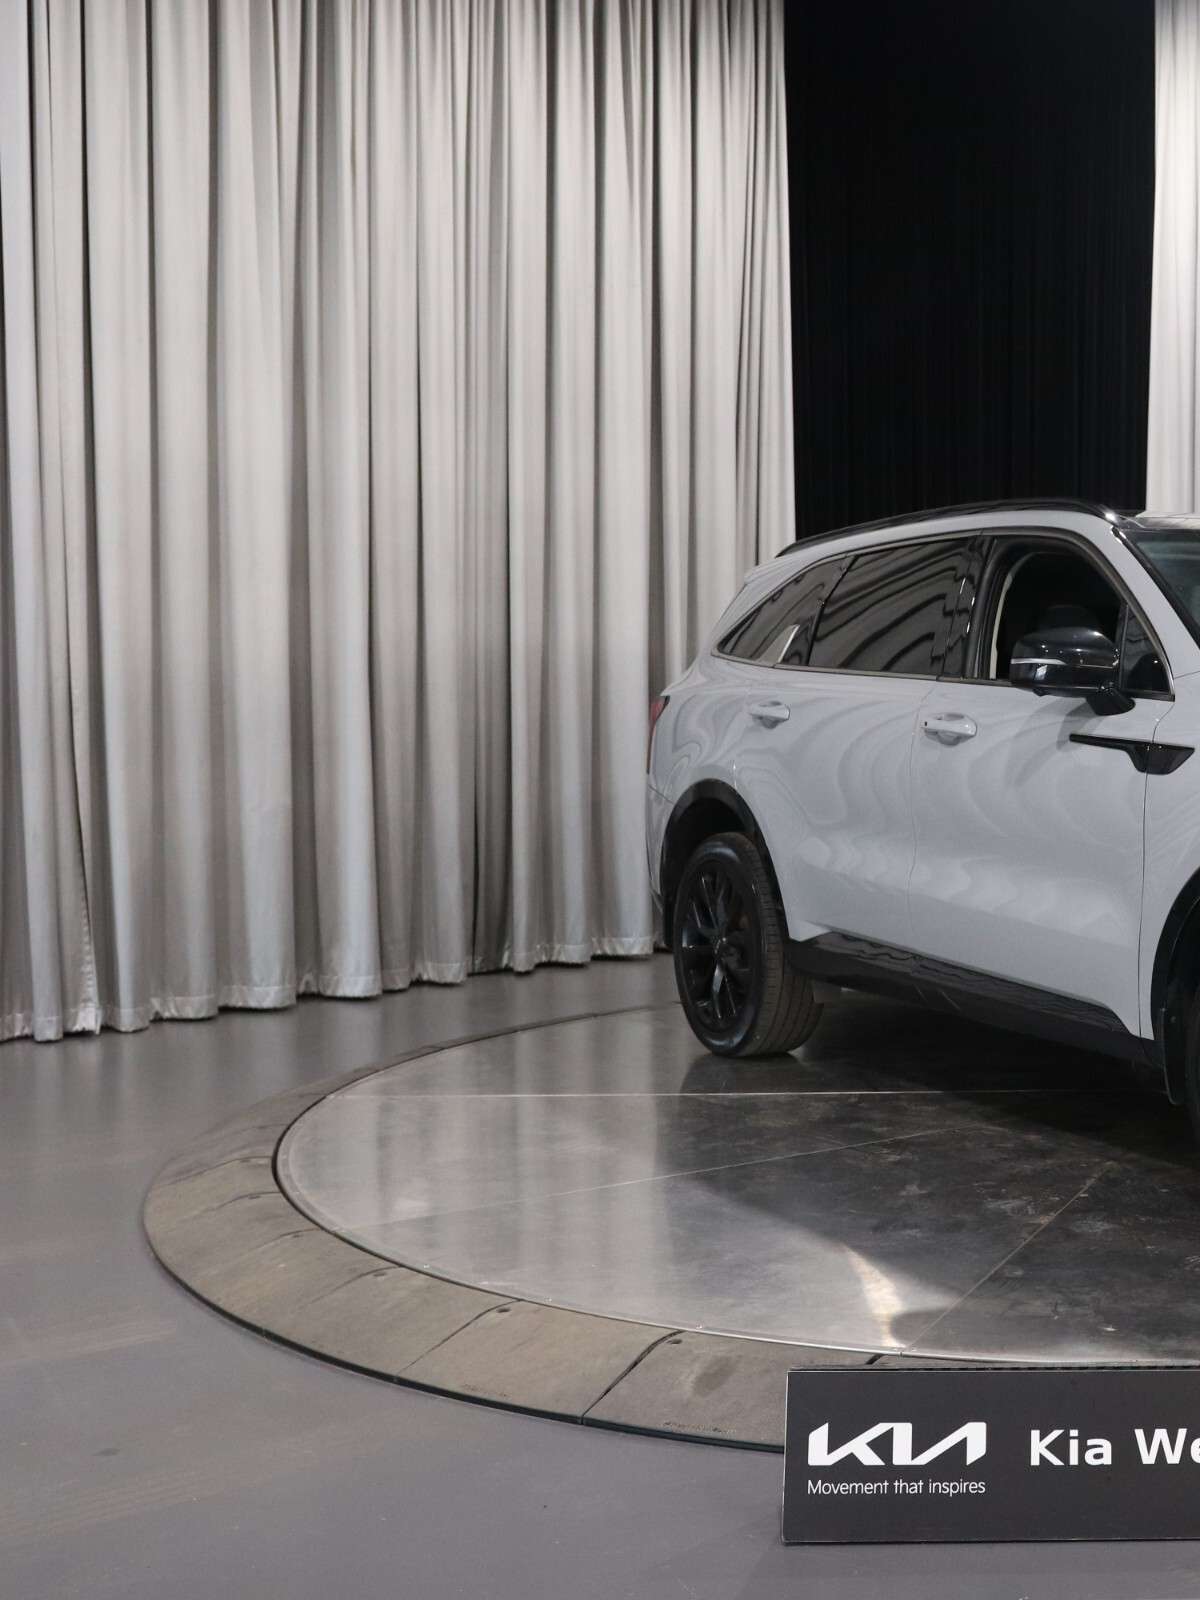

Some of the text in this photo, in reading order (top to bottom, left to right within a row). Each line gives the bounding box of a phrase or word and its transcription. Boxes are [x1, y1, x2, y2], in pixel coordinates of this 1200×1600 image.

[807, 1421, 987, 1467] KIA
[1030, 1429, 1112, 1466] Kia
[807, 1478, 987, 1498] Movement that inspires
